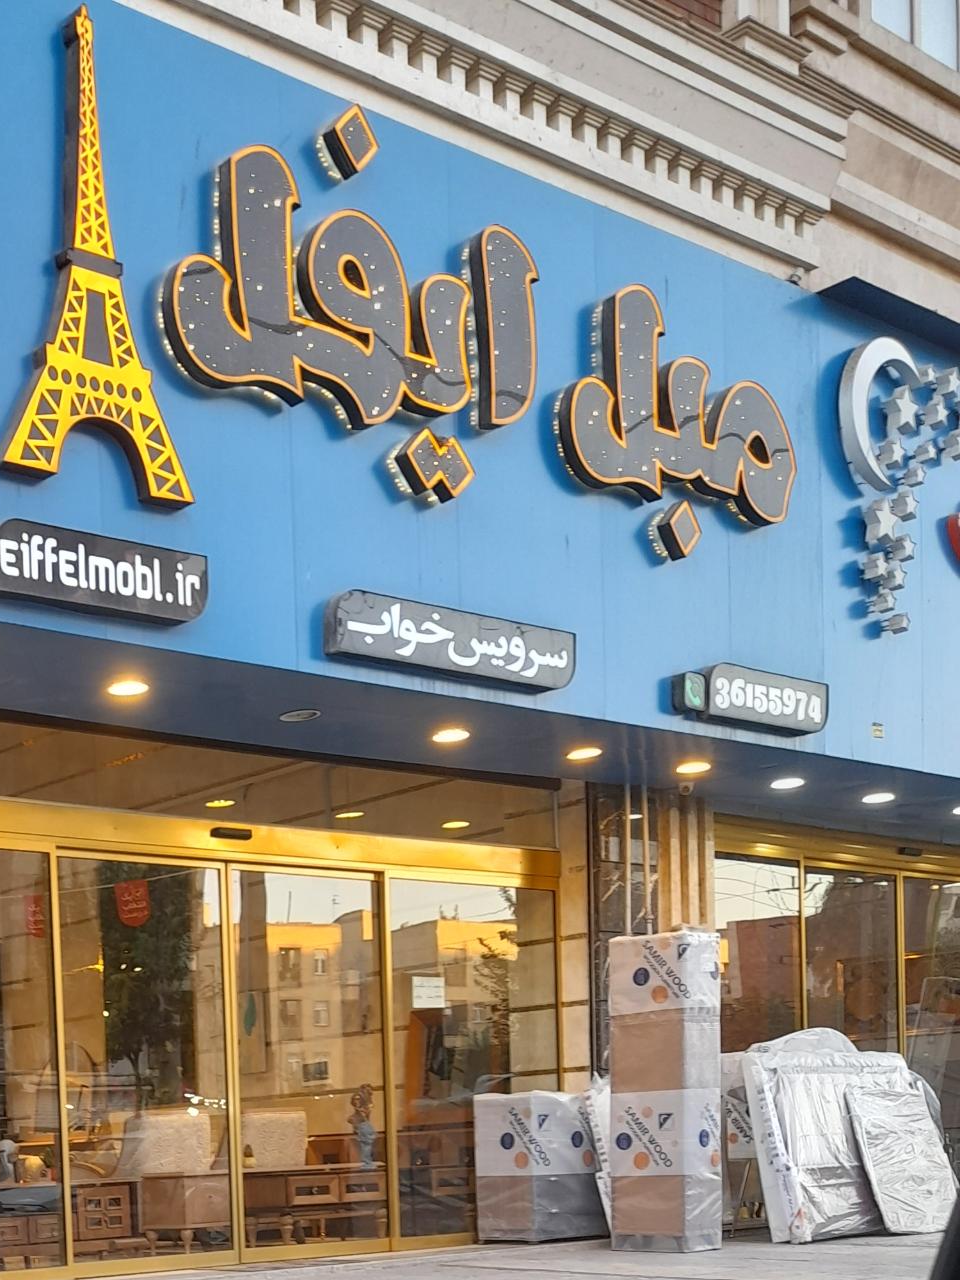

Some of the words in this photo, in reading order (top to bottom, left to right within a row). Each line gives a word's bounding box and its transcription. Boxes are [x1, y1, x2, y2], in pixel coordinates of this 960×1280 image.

[162, 103, 539, 504] ایفل
[559, 283, 797, 561] مبل
[347, 603, 455, 657] خواب
[447, 635, 568, 678] سرویس
[715, 677, 822, 723] 36155974
[642, 940, 667, 969] SAMIR
[624, 1105, 650, 1136] SAMIR
[647, 1134, 673, 1168] WOOD
